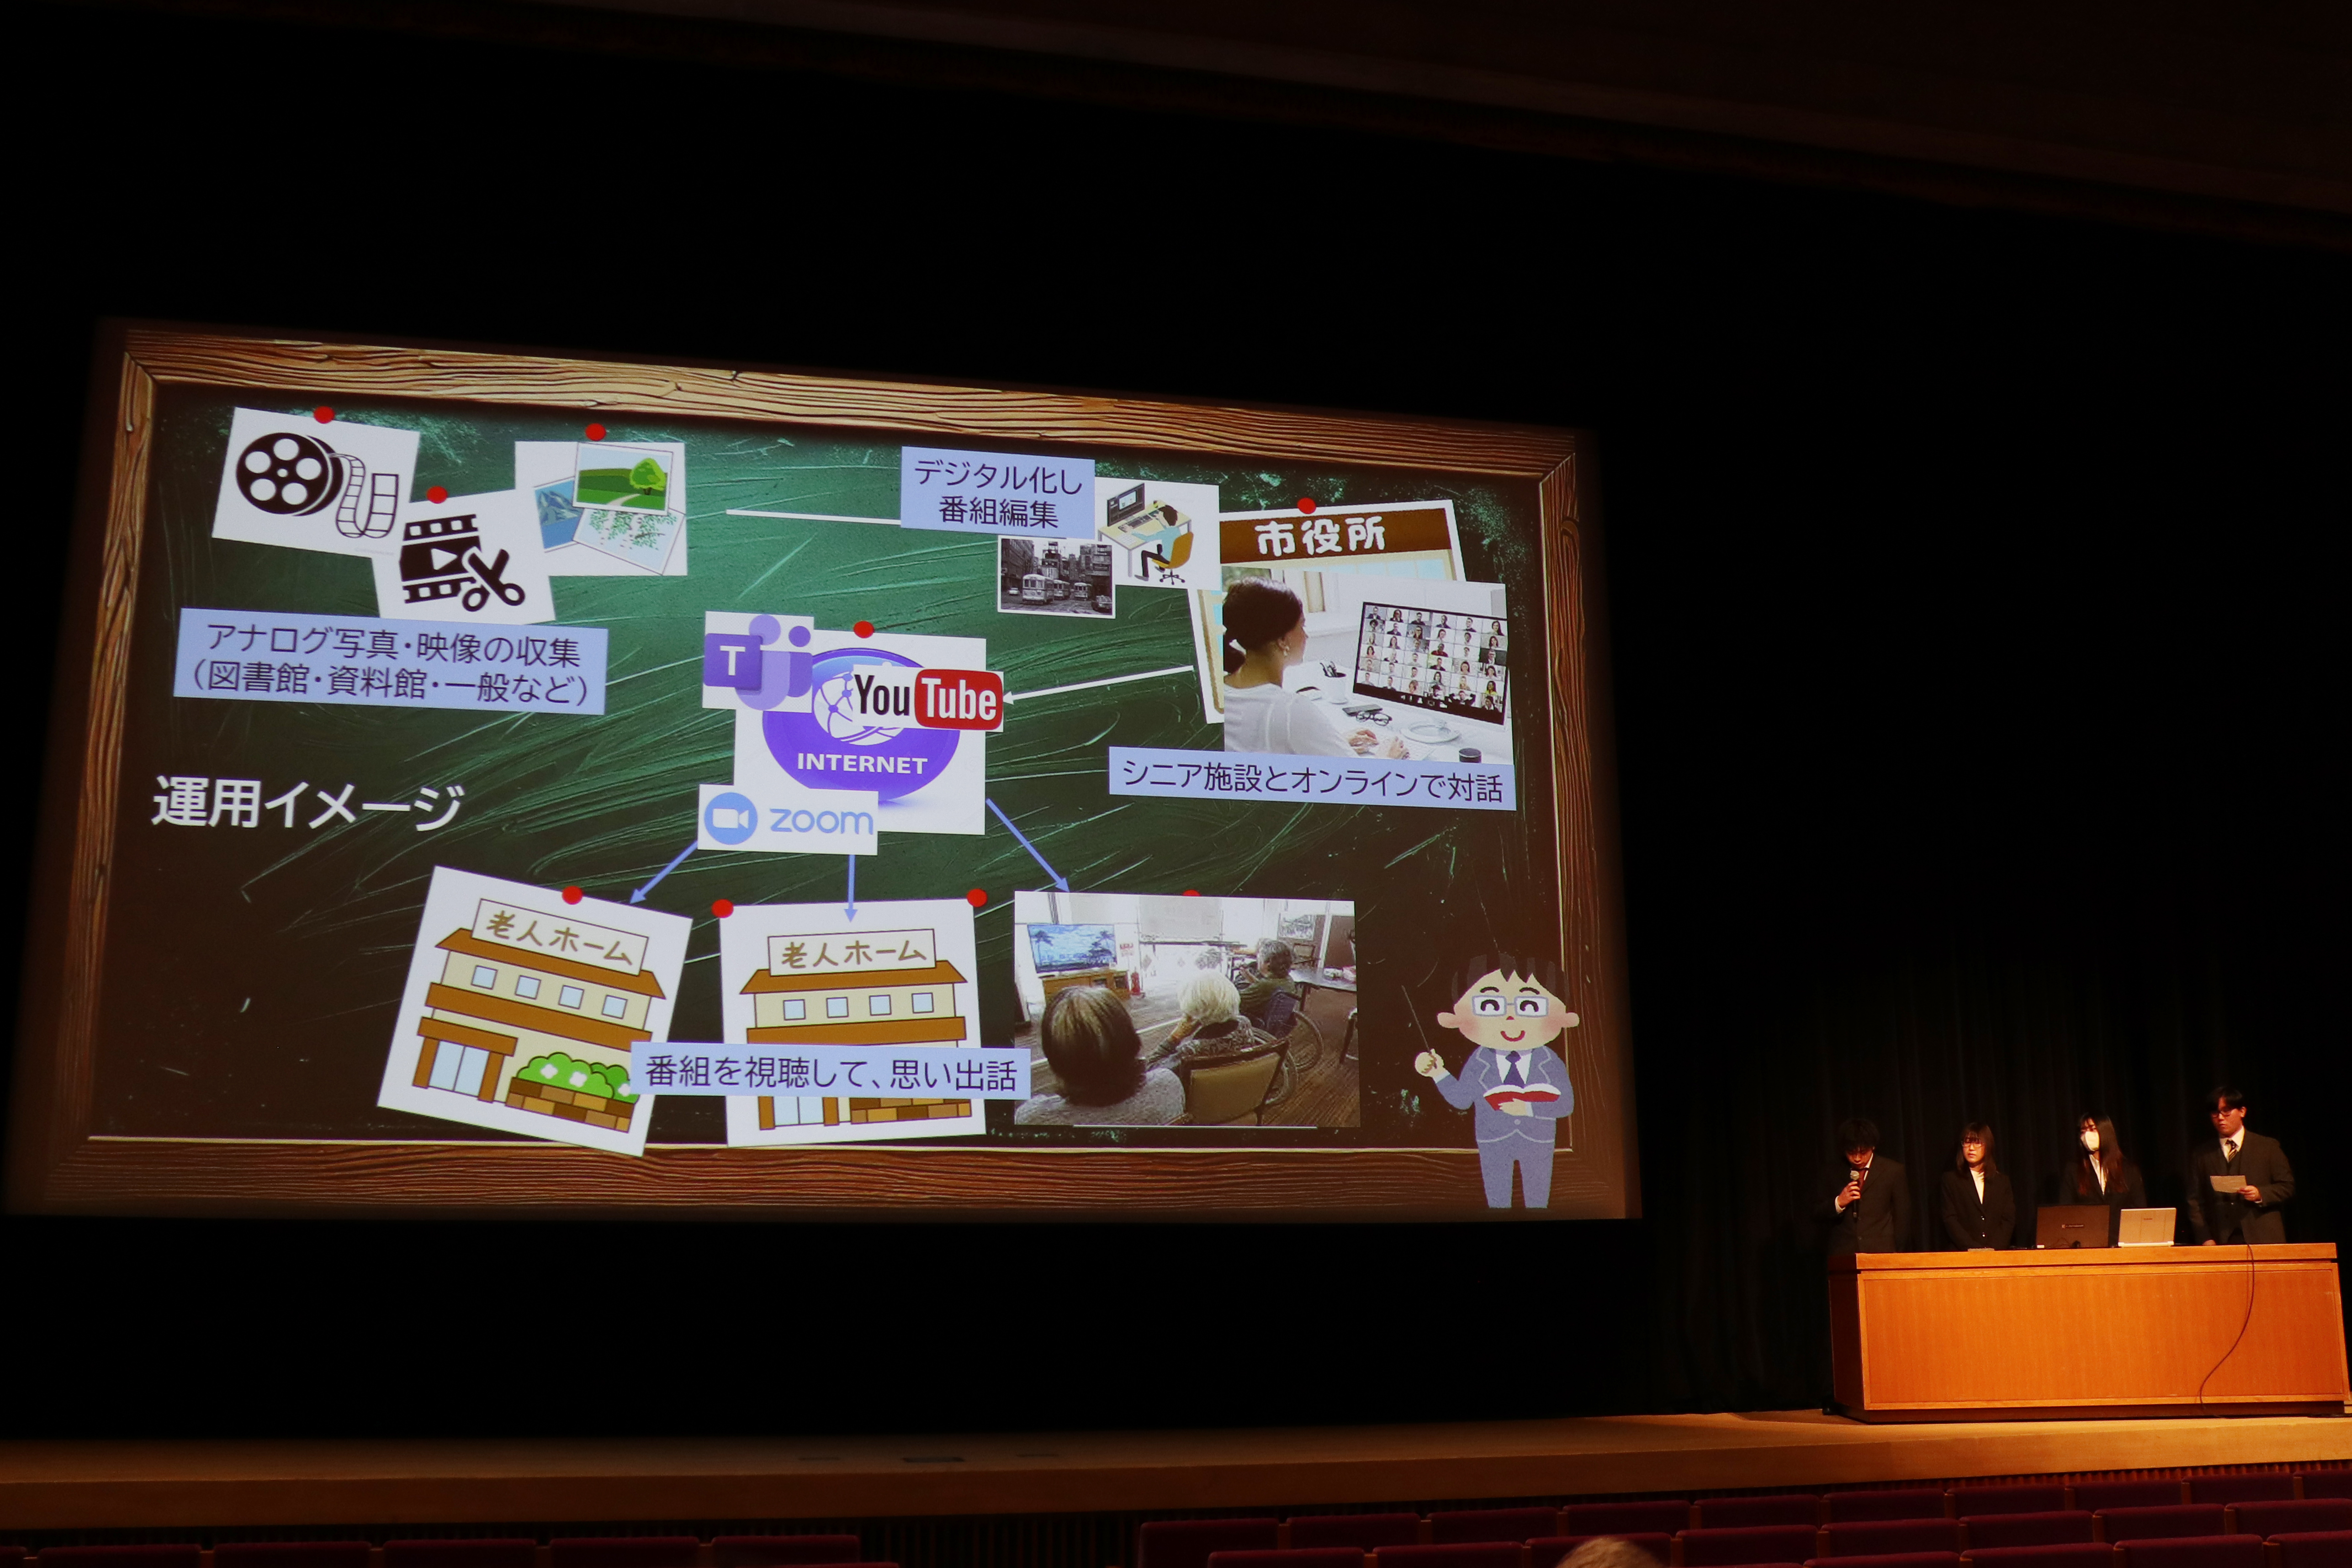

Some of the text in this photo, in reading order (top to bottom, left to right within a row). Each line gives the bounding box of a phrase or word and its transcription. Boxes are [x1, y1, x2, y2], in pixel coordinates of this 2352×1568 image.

[915, 459, 1083, 495] デジタル化し
[939, 496, 1058, 529] 番組編集
[1255, 516, 1386, 556] 市役所
[207, 624, 580, 668] アナログ写真・映像の収集
[720, 645, 746, 676] T
[194, 659, 588, 707] （図書館・資料館・一般など）
[797, 752, 928, 775] INTERNET
[1123, 759, 1503, 803] シニア施設とオンラインで対話
[151, 775, 464, 832] 運用イメージ
[770, 809, 874, 835] zoom
[486, 910, 633, 965] 老人ホーム
[781, 940, 927, 968] 老人ホーム
[646, 1055, 1017, 1091] 番組を視聴して、思い出話
